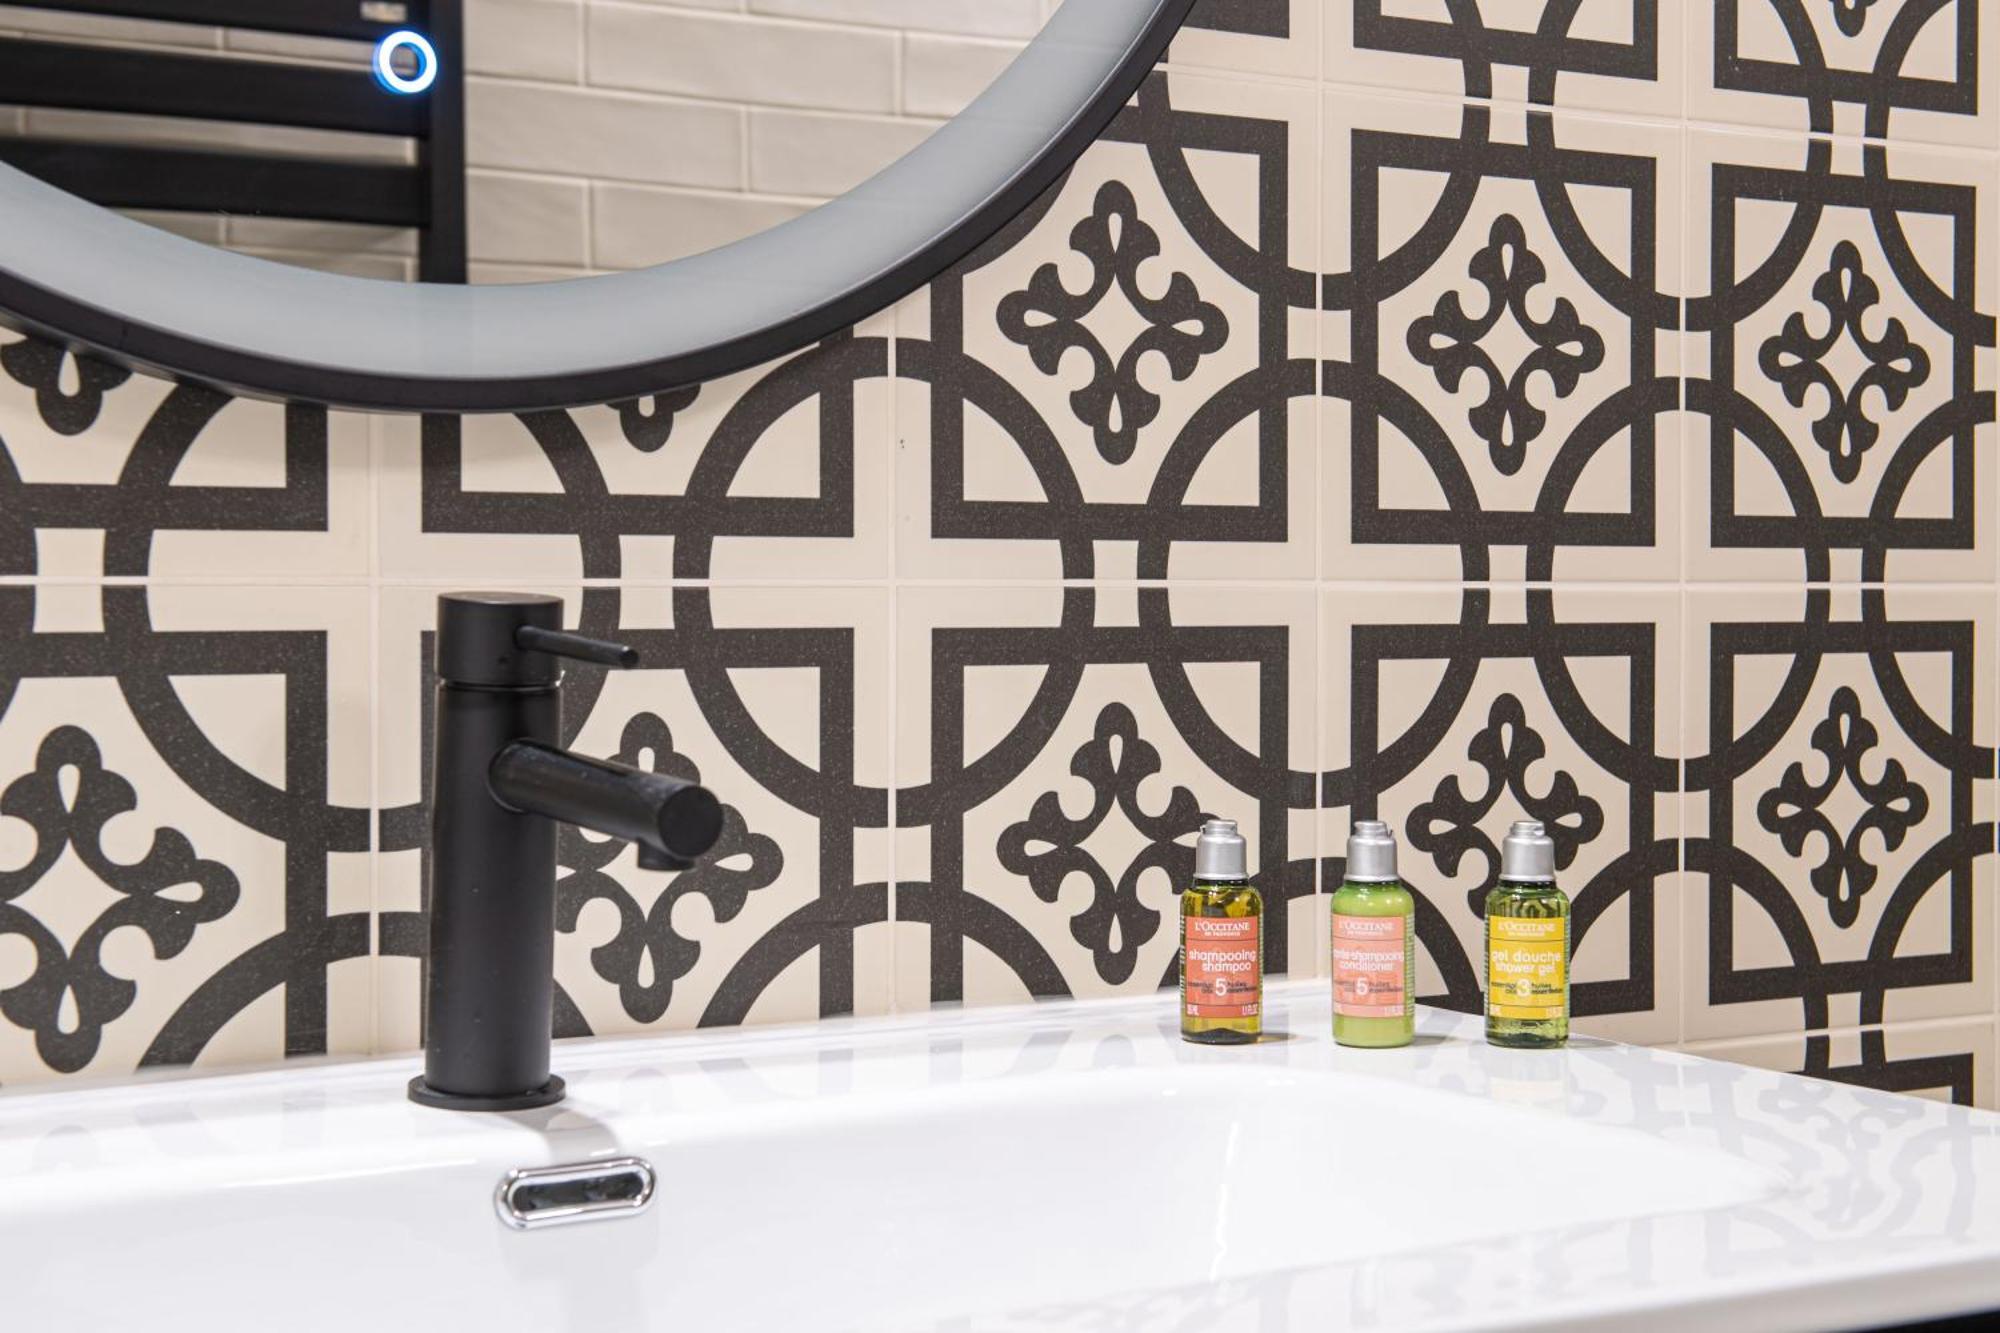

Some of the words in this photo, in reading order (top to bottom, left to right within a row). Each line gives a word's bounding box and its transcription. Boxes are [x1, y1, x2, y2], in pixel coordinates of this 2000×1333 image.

[1188, 949, 1257, 962] shampooing
[1491, 950, 1508, 963] gel
[1513, 950, 1561, 962] douche
[1202, 960, 1251, 974] shampoo
[1339, 960, 1394, 972] conditioner
[1495, 961, 1535, 973] shower
[1538, 963, 1557, 976] gel
[1215, 978, 1227, 996] 5
[1356, 977, 1368, 996] 5
[1516, 978, 1532, 997] 3
